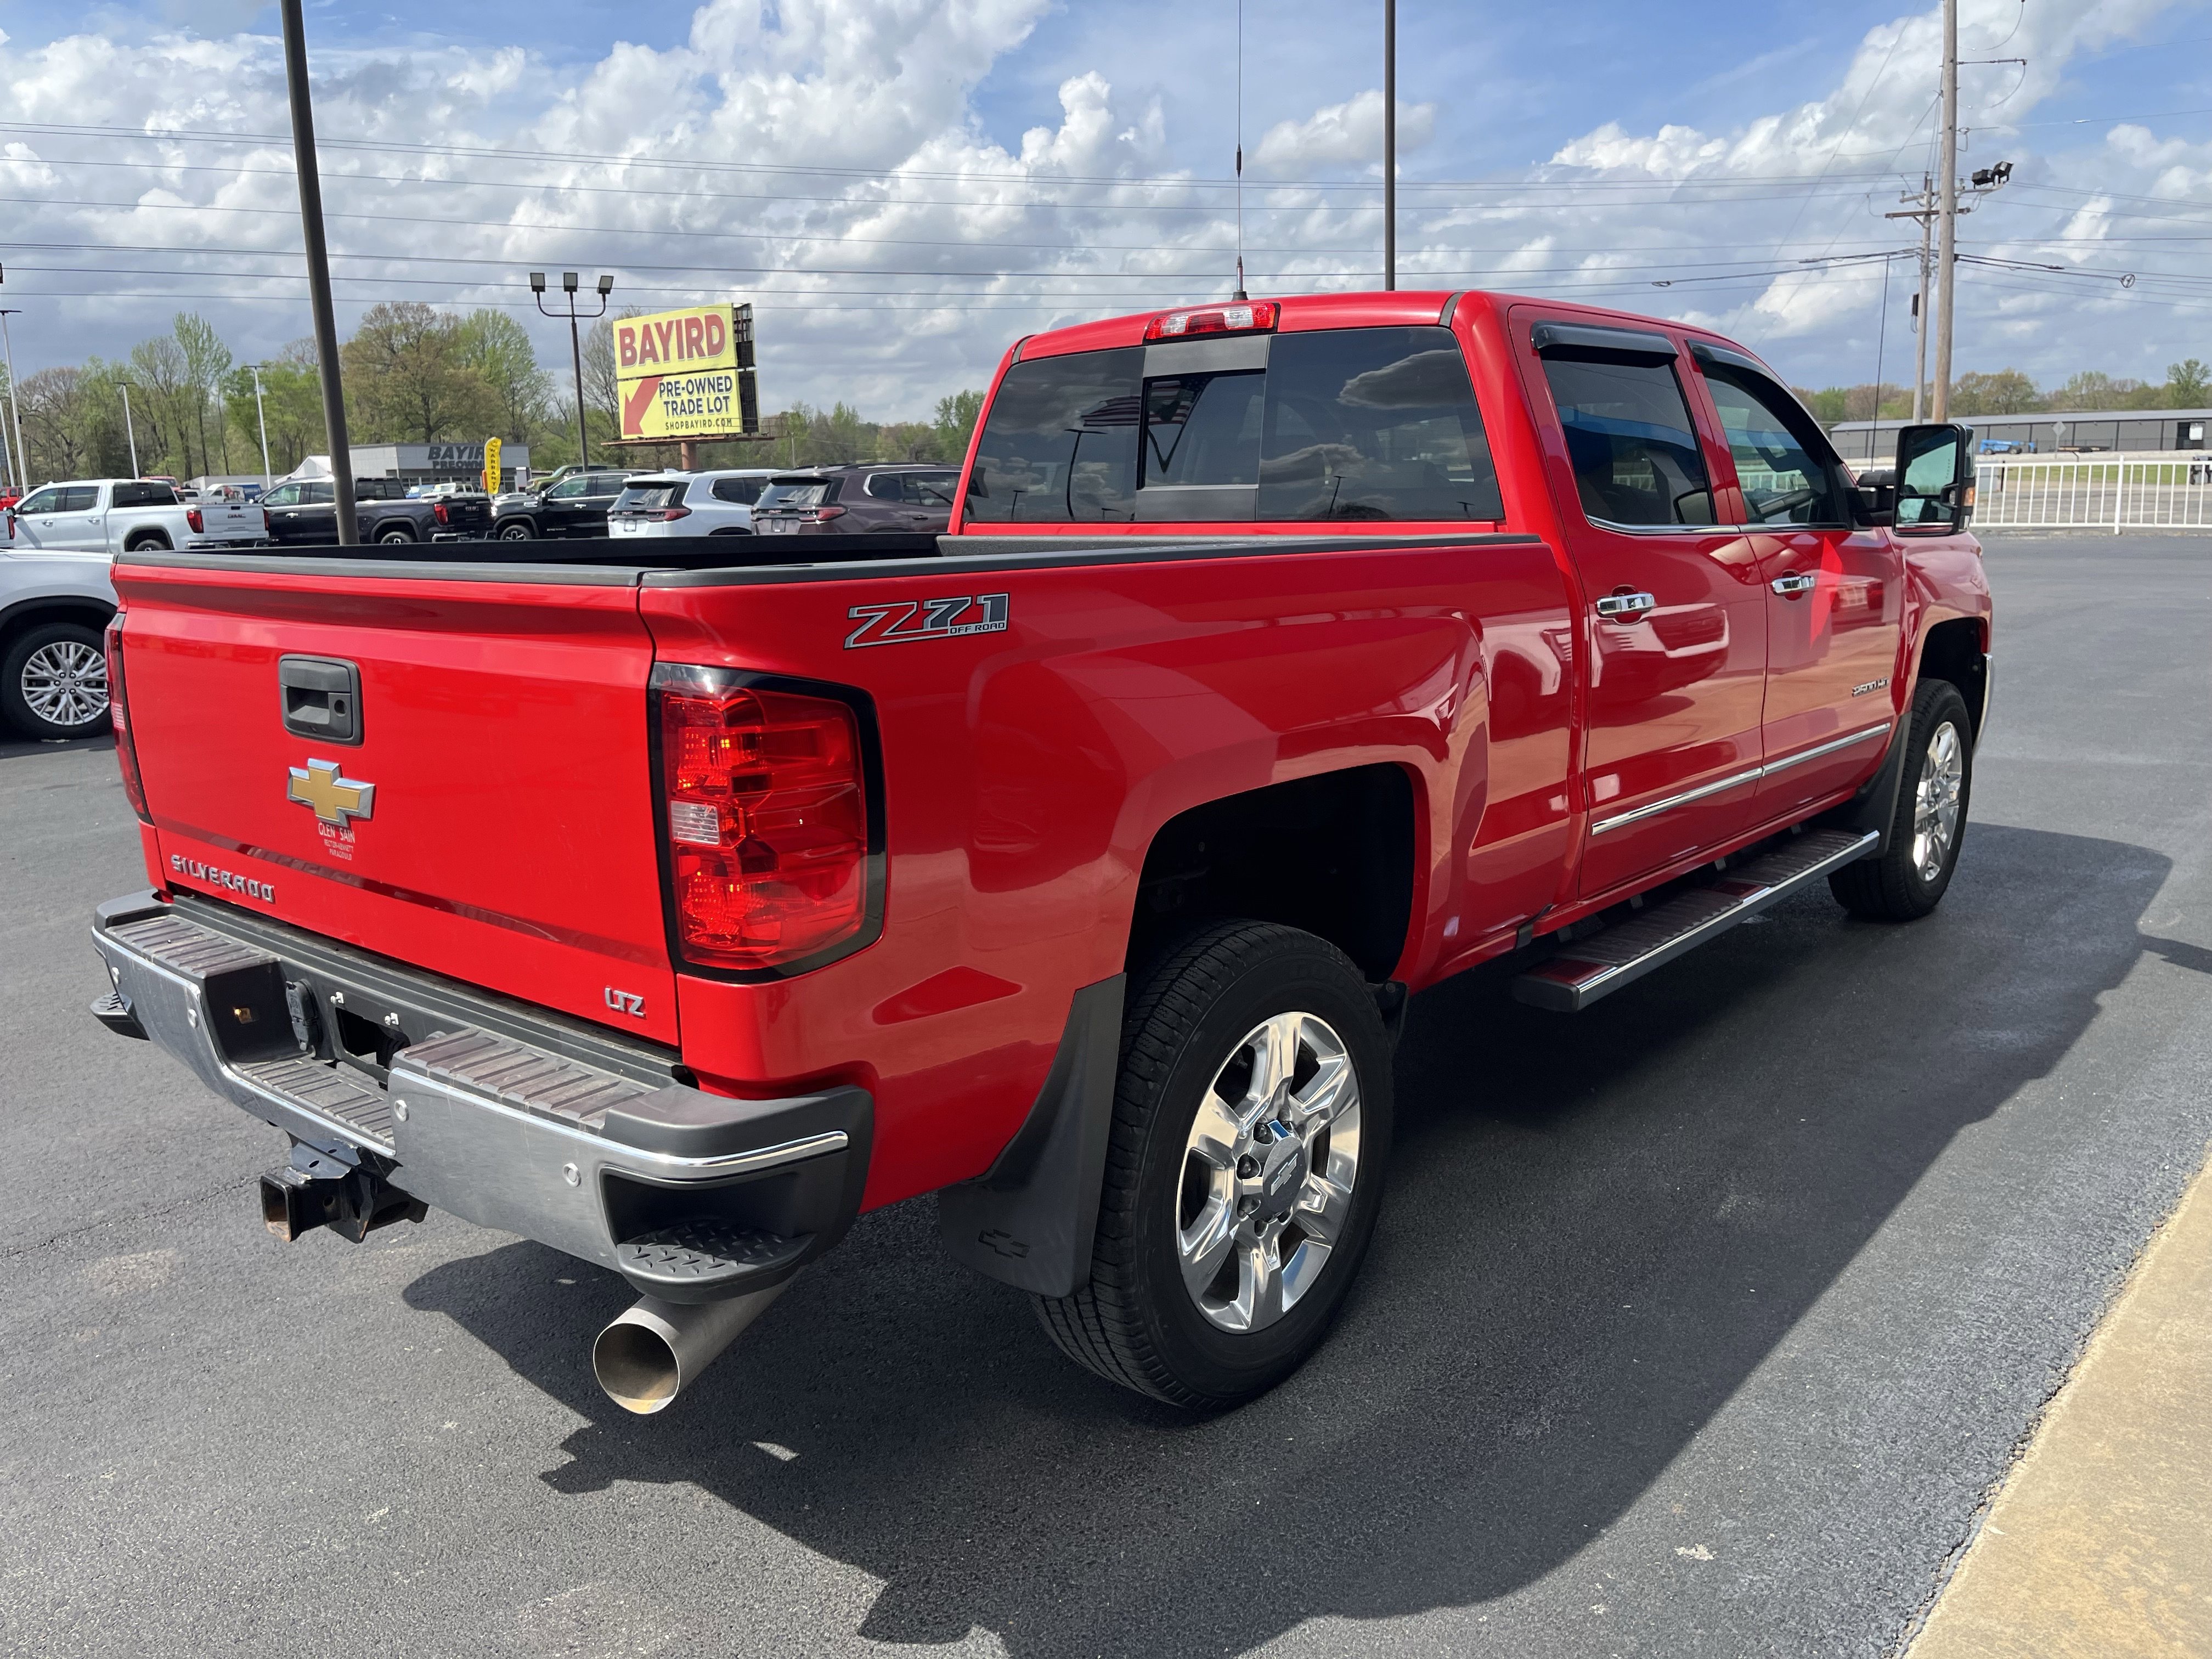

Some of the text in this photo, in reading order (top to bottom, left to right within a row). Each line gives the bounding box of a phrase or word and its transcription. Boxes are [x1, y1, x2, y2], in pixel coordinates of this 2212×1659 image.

[619, 313, 725, 367] BAYIRD
[659, 375, 732, 399] PRE-OWNED
[663, 396, 730, 417] TRADE LOT
[665, 418, 732, 430] SHOPBAYIRD.COM
[428, 446, 484, 460] BAYIR
[432, 460, 484, 469] PREOWN
[844, 592, 1009, 650] Z71
[950, 622, 1005, 635] OFF ROAD
[318, 822, 355, 844] GLEN SAIN
[171, 854, 275, 904] SILVERADO
[605, 988, 644, 1017] LTZ
